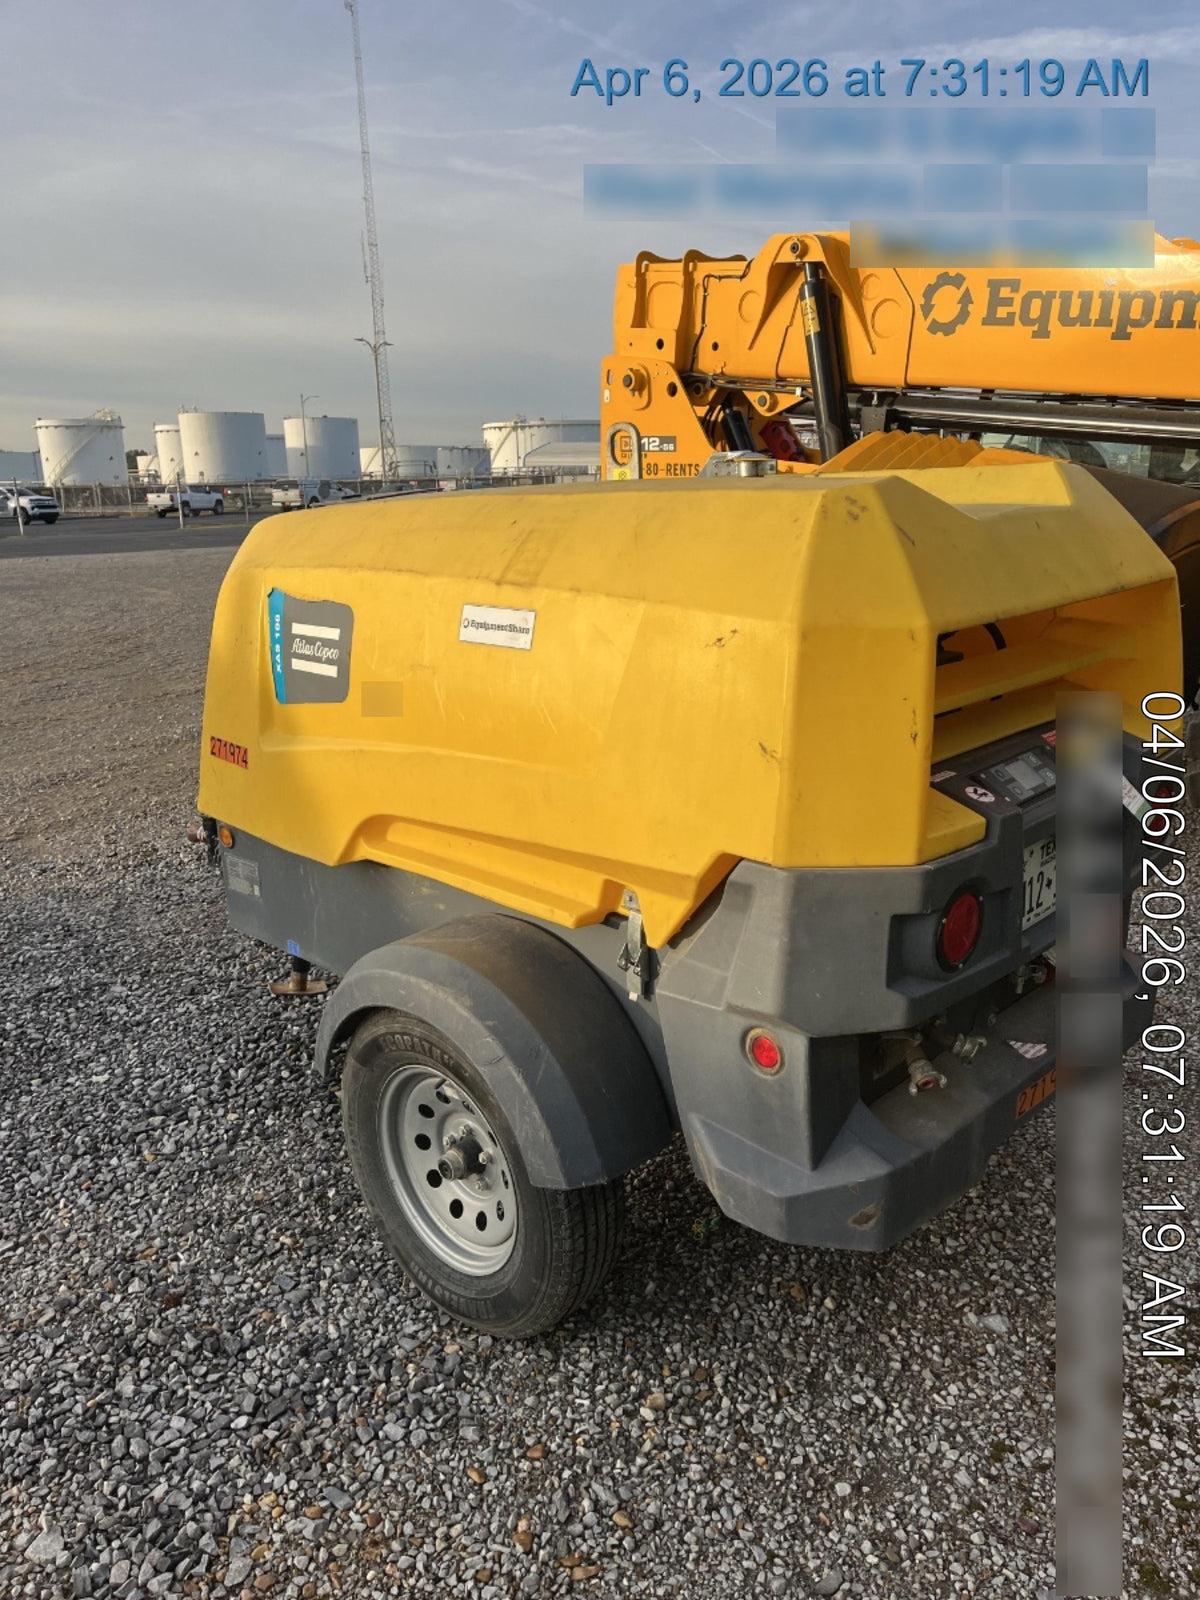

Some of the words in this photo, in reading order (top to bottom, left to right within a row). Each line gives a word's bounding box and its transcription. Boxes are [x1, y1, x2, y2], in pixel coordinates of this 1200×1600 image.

[290, 638, 314, 656] Atlas
[314, 641, 340, 662] Copco
[210, 736, 248, 769] 271974
